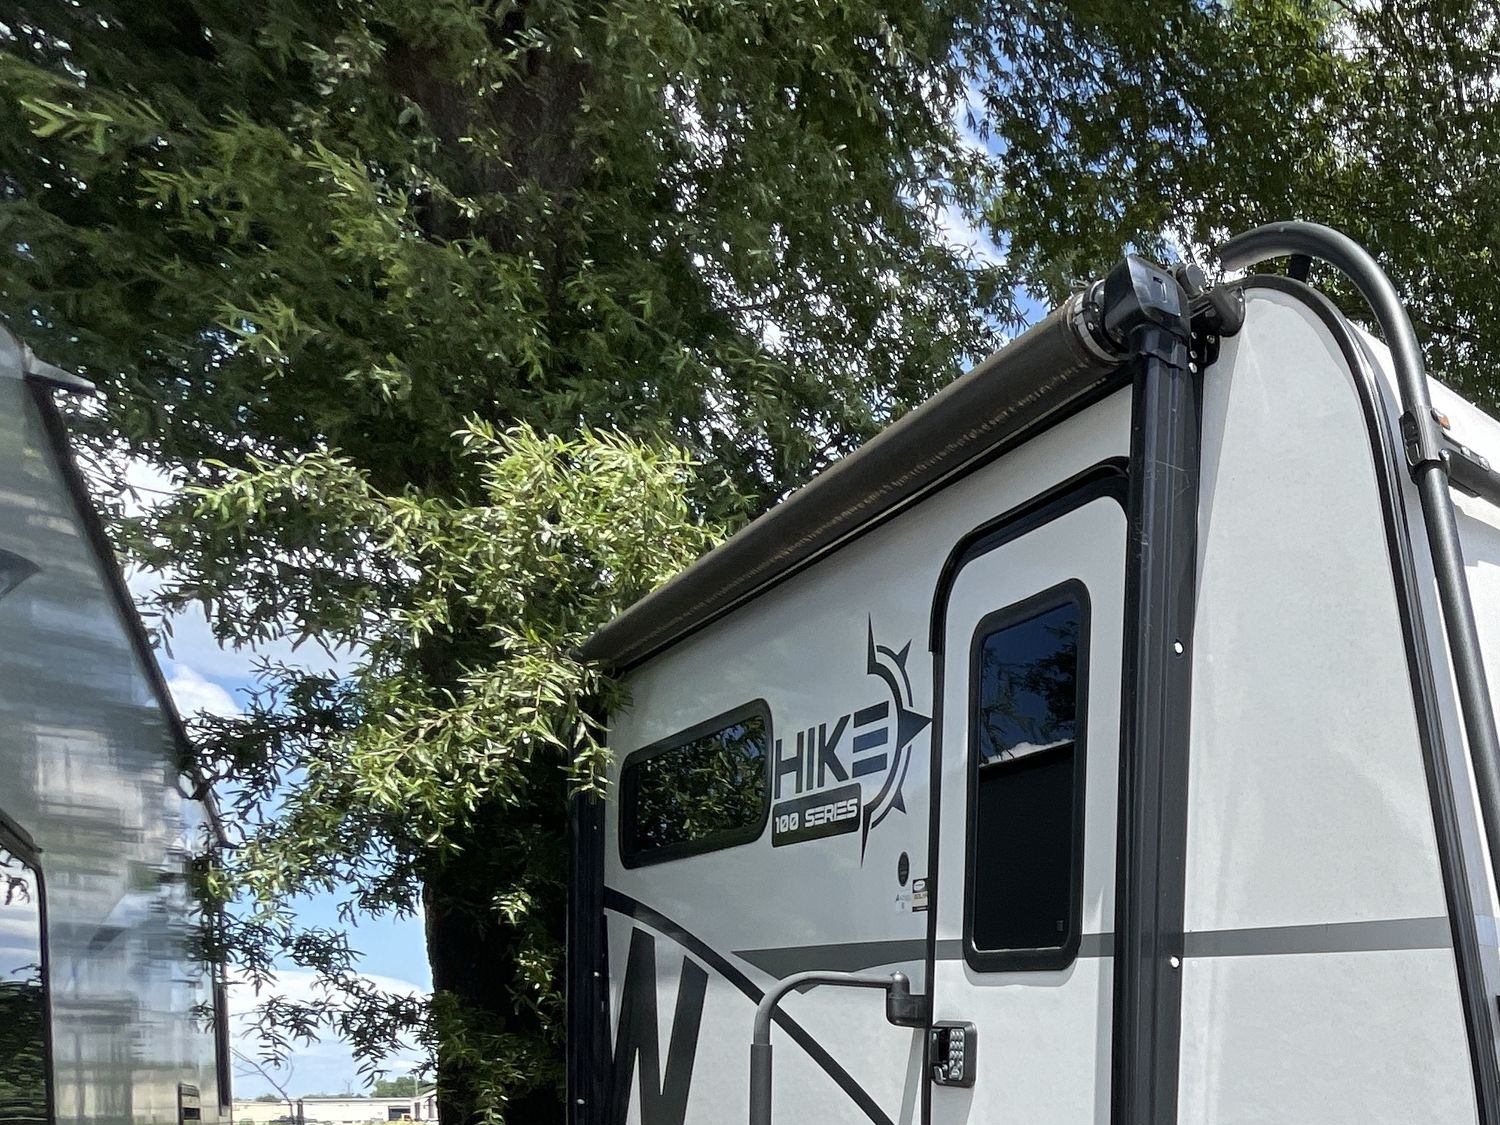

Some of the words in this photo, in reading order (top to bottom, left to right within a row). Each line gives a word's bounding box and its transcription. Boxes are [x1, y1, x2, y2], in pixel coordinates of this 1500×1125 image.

[774, 700, 889, 800] HIKE
[775, 812, 799, 834] 100
[804, 798, 858, 828] SERIES
